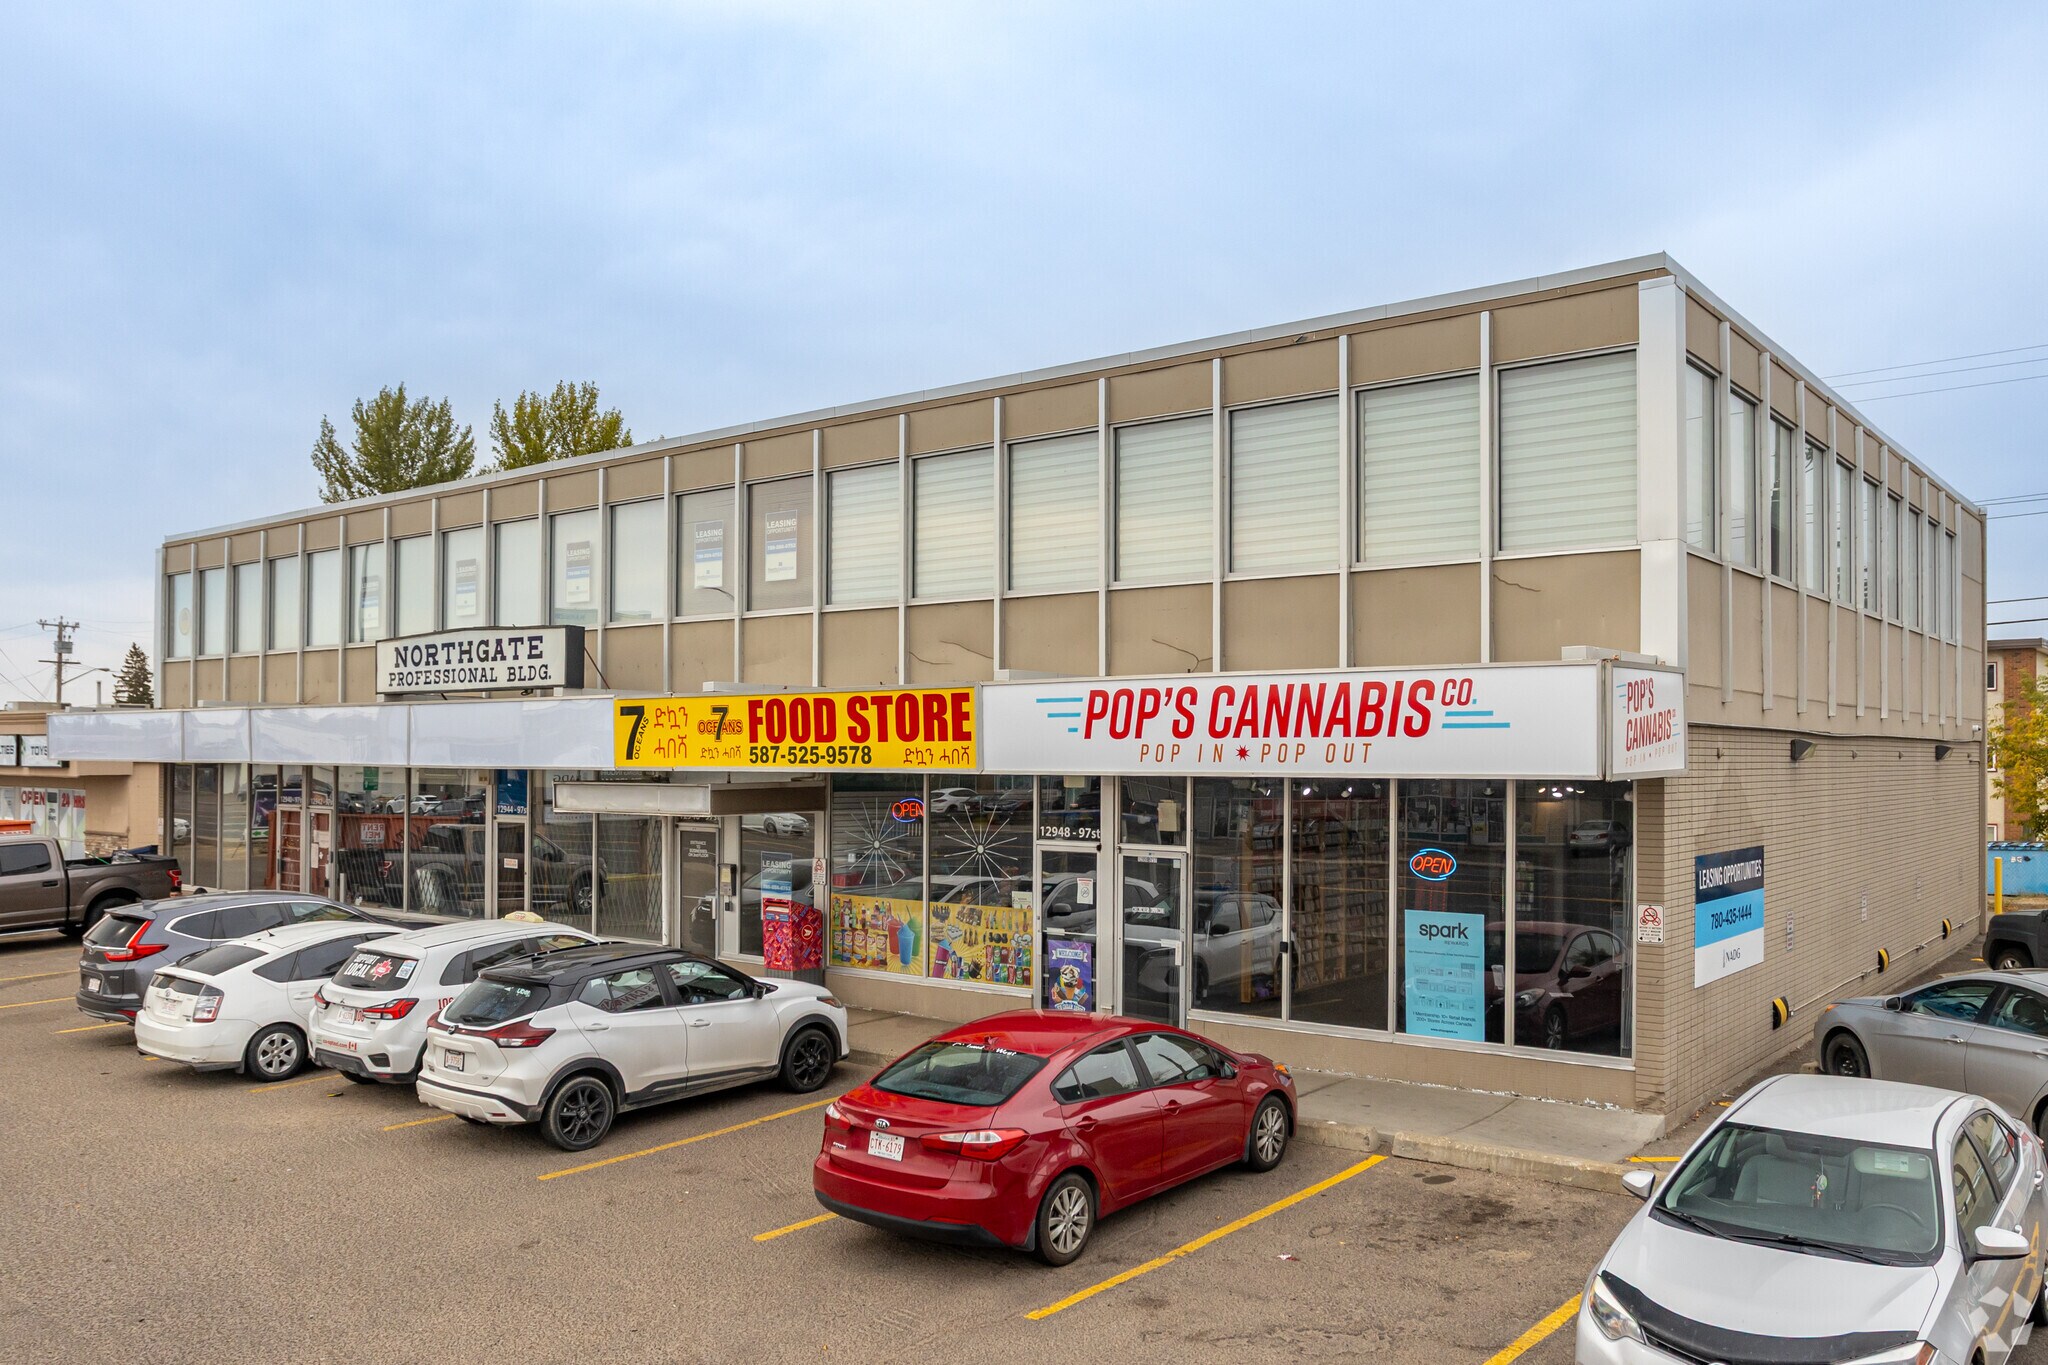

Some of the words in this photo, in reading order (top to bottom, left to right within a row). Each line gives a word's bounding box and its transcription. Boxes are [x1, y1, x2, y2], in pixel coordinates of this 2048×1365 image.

[767, 518, 797, 529] LEASING
[767, 527, 797, 535] OPPORTUNITY
[695, 528, 723, 539] LEASING
[566, 548, 590, 557] LEASING
[394, 635, 544, 668] NORTHGATE
[388, 667, 498, 687] PROFESSIONAL
[506, 664, 552, 682] BLDG.
[1627, 677, 1654, 714] POP'S
[748, 697, 837, 744] FOOD
[846, 692, 972, 744] STORE
[1083, 686, 1199, 740] POP'S
[1207, 678, 1436, 739] CANNABIS
[1440, 677, 1478, 706] CO.
[711, 704, 729, 742] 7
[1626, 709, 1672, 752] CANNABIS
[620, 705, 645, 761] 7
[634, 716, 650, 760] OCEANS
[749, 745, 872, 765] 587-525-9578
[1140, 743, 1181, 763] POP
[1198, 743, 1225, 763] IN
[1260, 743, 1306, 763] POP
[1325, 742, 1373, 763] OUT
[21, 790, 45, 806] OPEN
[892, 803, 924, 818] OPEN
[1040, 826, 1070, 838] 12948
[1078, 827, 1100, 839] 97st
[762, 860, 792, 870] LEASING
[1412, 856, 1452, 874] OPEN
[1699, 867, 1723, 890] LEASING
[1723, 859, 1762, 884] OPPORTUNITIES
[1711, 904, 1752, 930] 780-435-1444
[1419, 923, 1469, 941] spark
[1726, 948, 1741, 963] NADG
[343, 963, 371, 978] LOCAL
[874, 1119, 889, 1129] KIA
